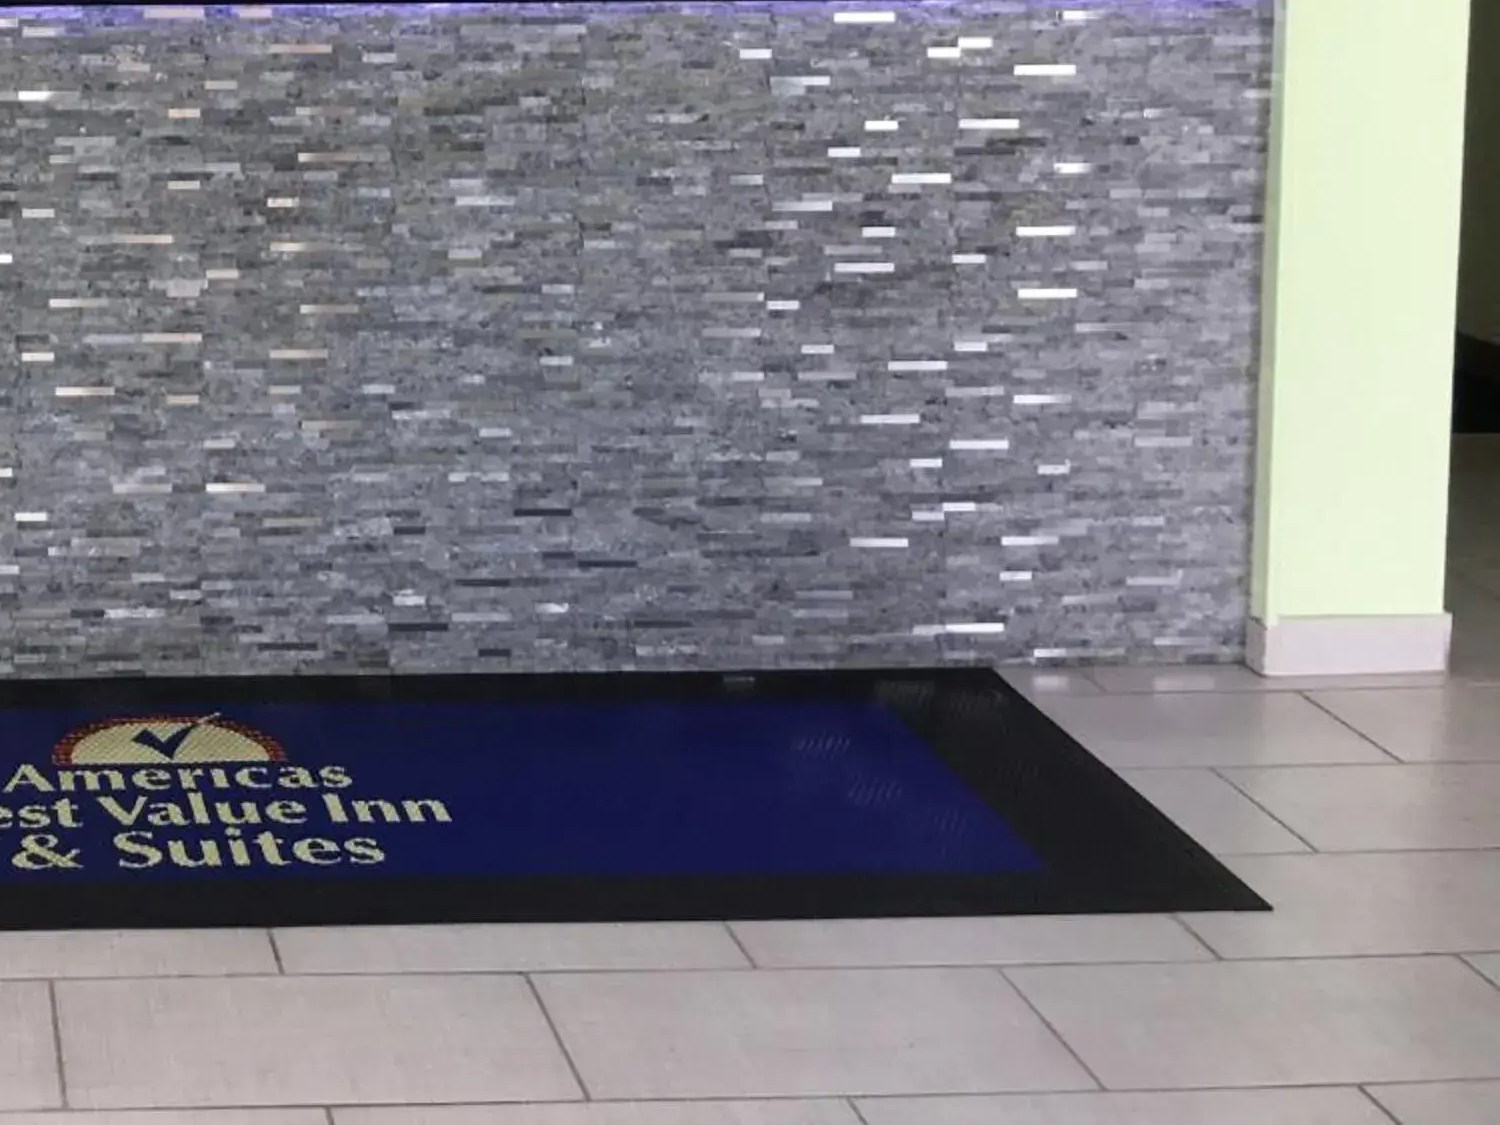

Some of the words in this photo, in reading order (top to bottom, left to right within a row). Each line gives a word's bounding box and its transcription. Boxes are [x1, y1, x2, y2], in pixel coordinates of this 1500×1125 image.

[3, 763, 354, 792] Americas
[97, 791, 308, 826] Value
[320, 792, 453, 823] Inn
[11, 833, 84, 870] &
[113, 827, 387, 868] Suites
